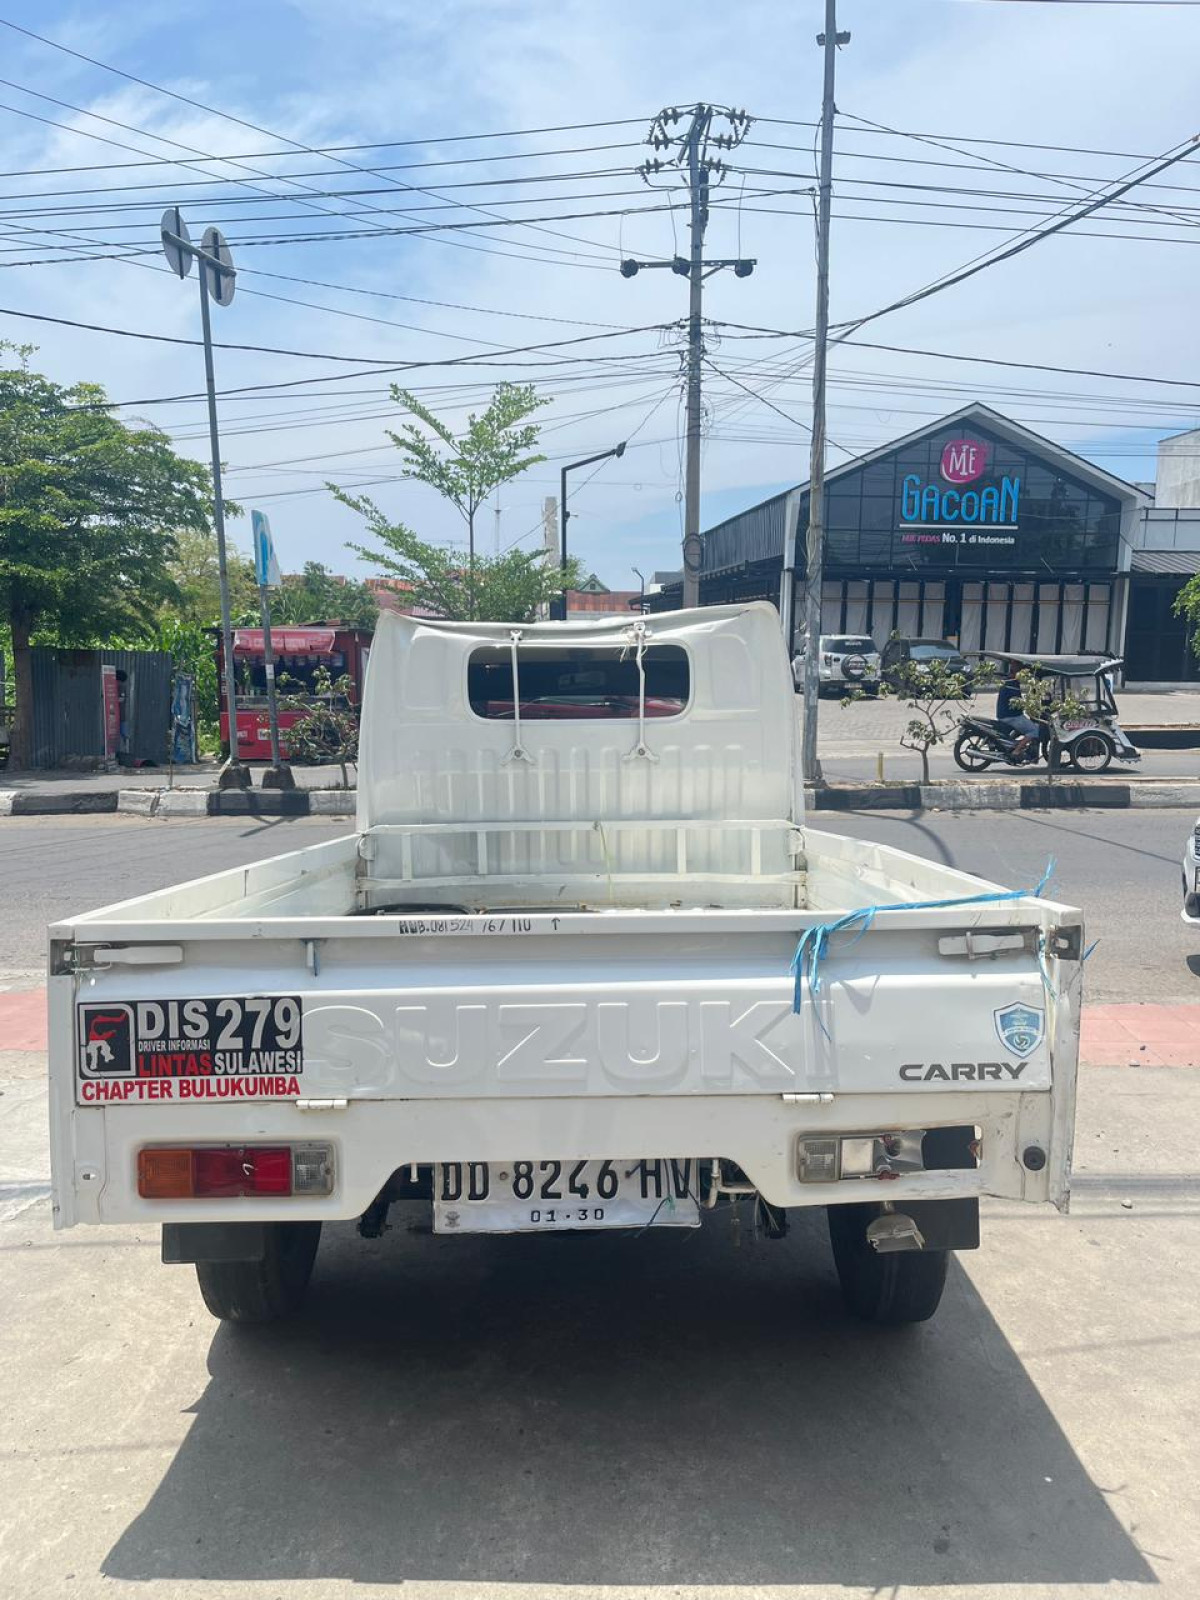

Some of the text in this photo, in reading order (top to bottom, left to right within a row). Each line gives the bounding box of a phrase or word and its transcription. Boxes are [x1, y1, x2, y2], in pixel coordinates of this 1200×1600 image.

[949, 445, 976, 476] MIE
[901, 474, 1020, 522] GACOAN
[942, 532, 958, 543] No.
[960, 532, 967, 543] 1
[968, 534, 977, 543] di
[978, 535, 1015, 544] Indonesia
[136, 998, 300, 1050] DIS 279
[138, 1039, 211, 1052] DRIVER INFORMASI
[300, 1001, 839, 1094] SUZUKI
[138, 1051, 302, 1077] LINTAS SULAWESI
[899, 1062, 1028, 1081] CARRY
[81, 1076, 301, 1101] CHAPTER BULUKUMBA
[441, 1158, 692, 1201] DD 8246 HV
